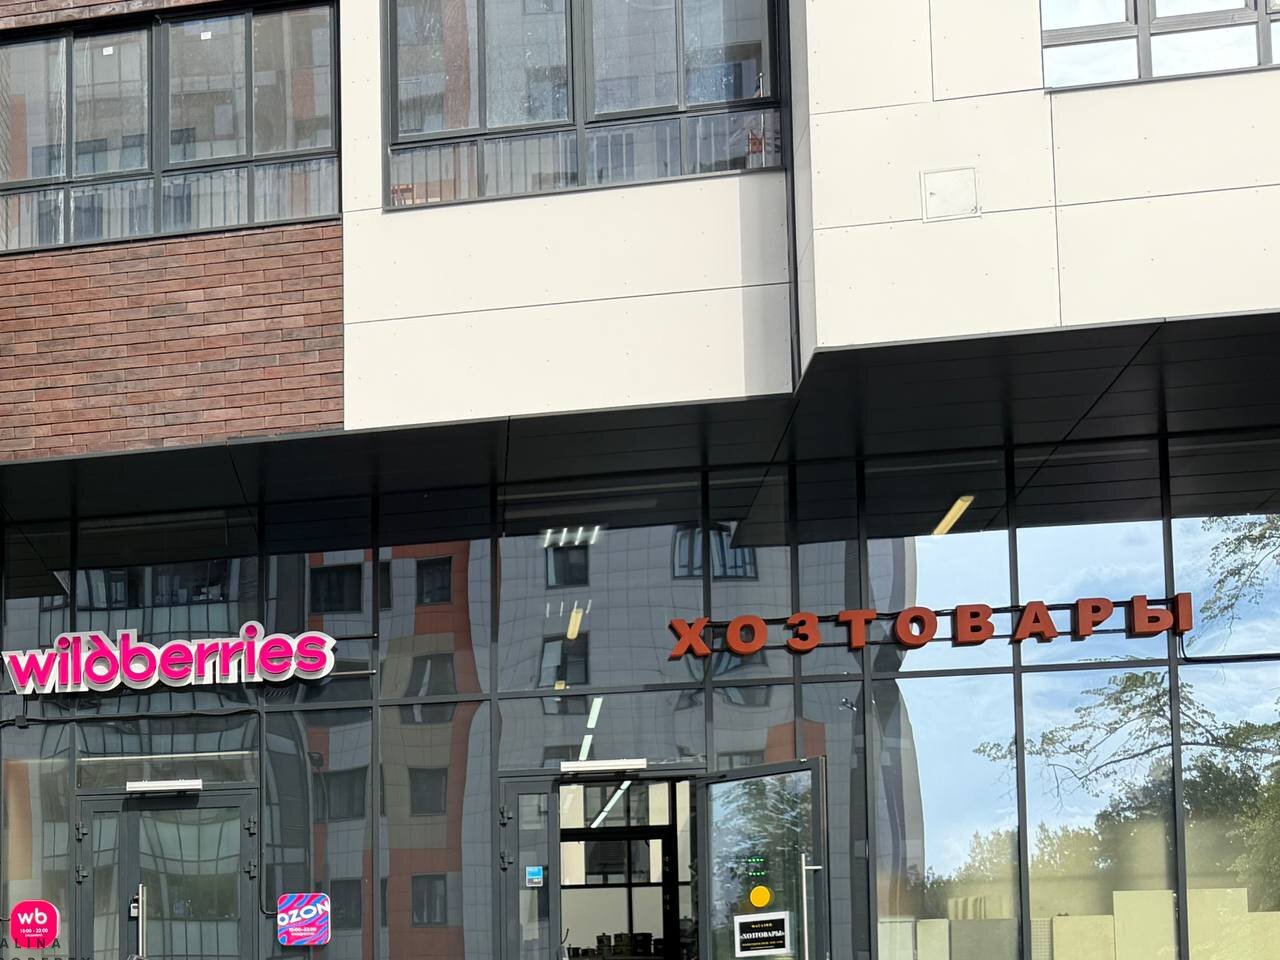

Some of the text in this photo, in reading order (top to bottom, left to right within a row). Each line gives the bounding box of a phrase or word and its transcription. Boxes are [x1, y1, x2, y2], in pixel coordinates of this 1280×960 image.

[668, 592, 1192, 660] ХОЗТОВАРЫ
[3, 621, 333, 693] wildberries
[17, 907, 48, 925] wb
[277, 901, 329, 926] OZON
